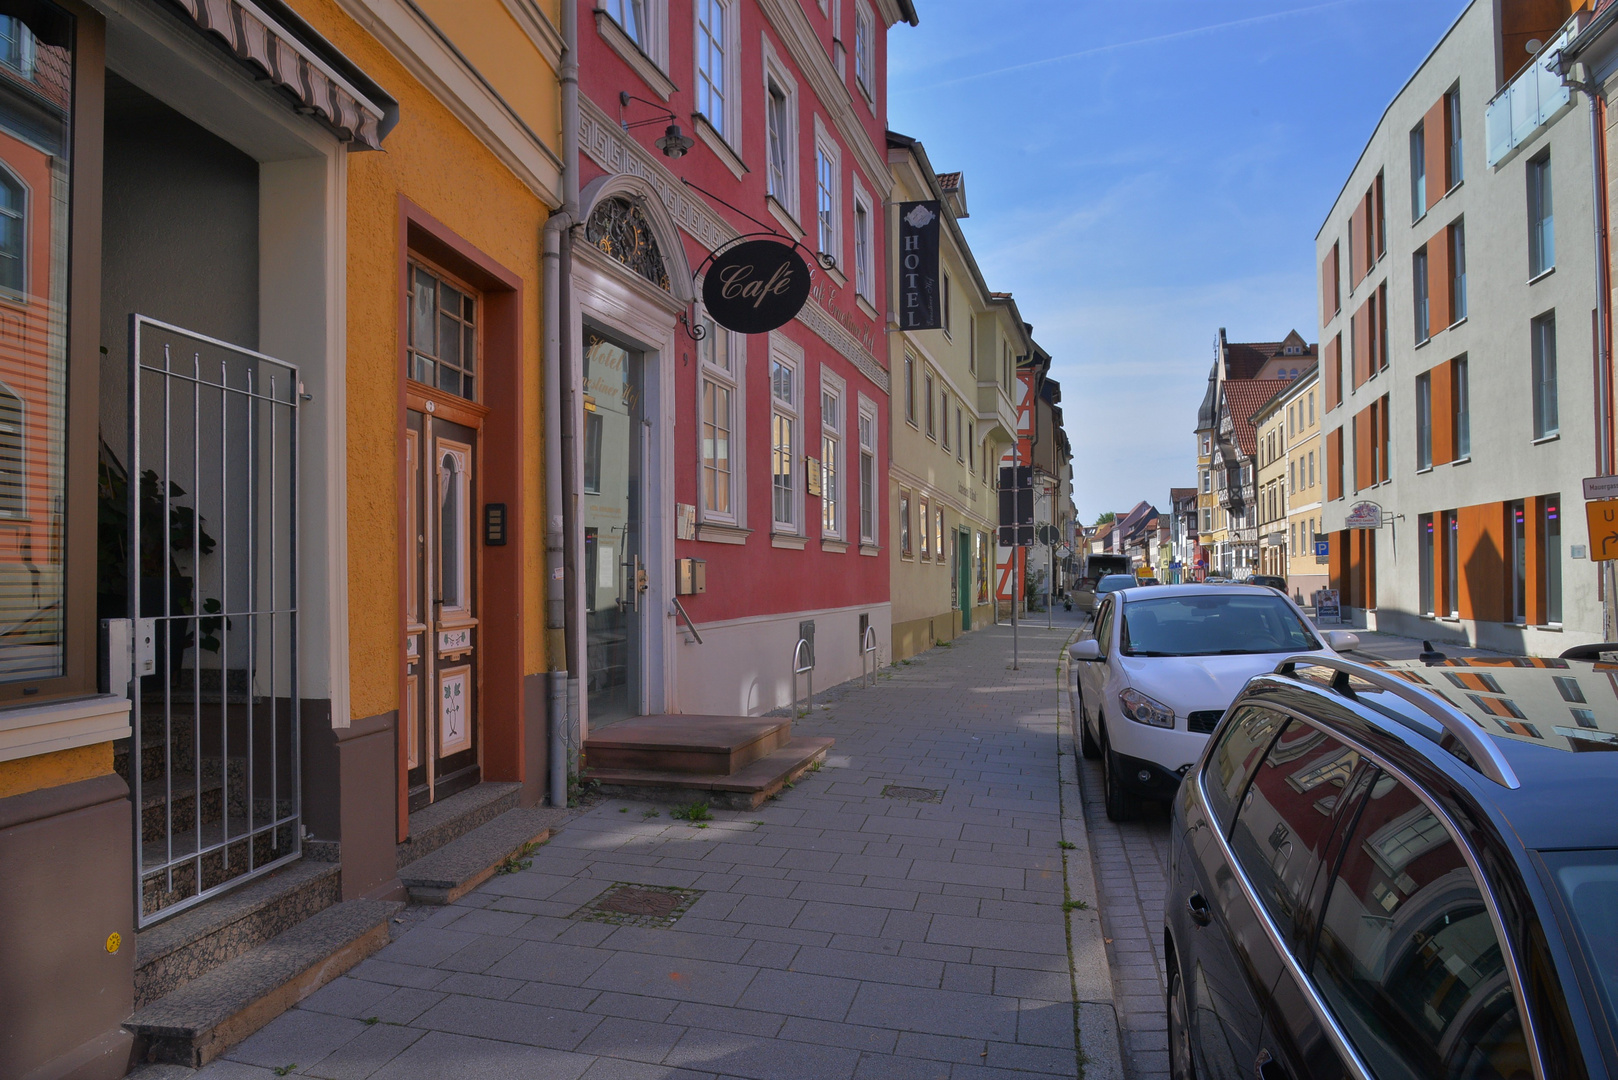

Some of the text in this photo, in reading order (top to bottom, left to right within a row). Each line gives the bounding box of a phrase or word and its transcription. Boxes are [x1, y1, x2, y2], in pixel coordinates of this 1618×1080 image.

[719, 260, 795, 309] Café
[904, 235, 920, 326] HOTEL
[586, 335, 626, 371] Hotel
[862, 322, 876, 356] Hof
[683, 352, 689, 367] 9
[583, 377, 640, 410] nestiner Hof
[1589, 483, 1618, 491] Mauergass
[1603, 508, 1615, 522] U
[1318, 543, 1327, 555] P
